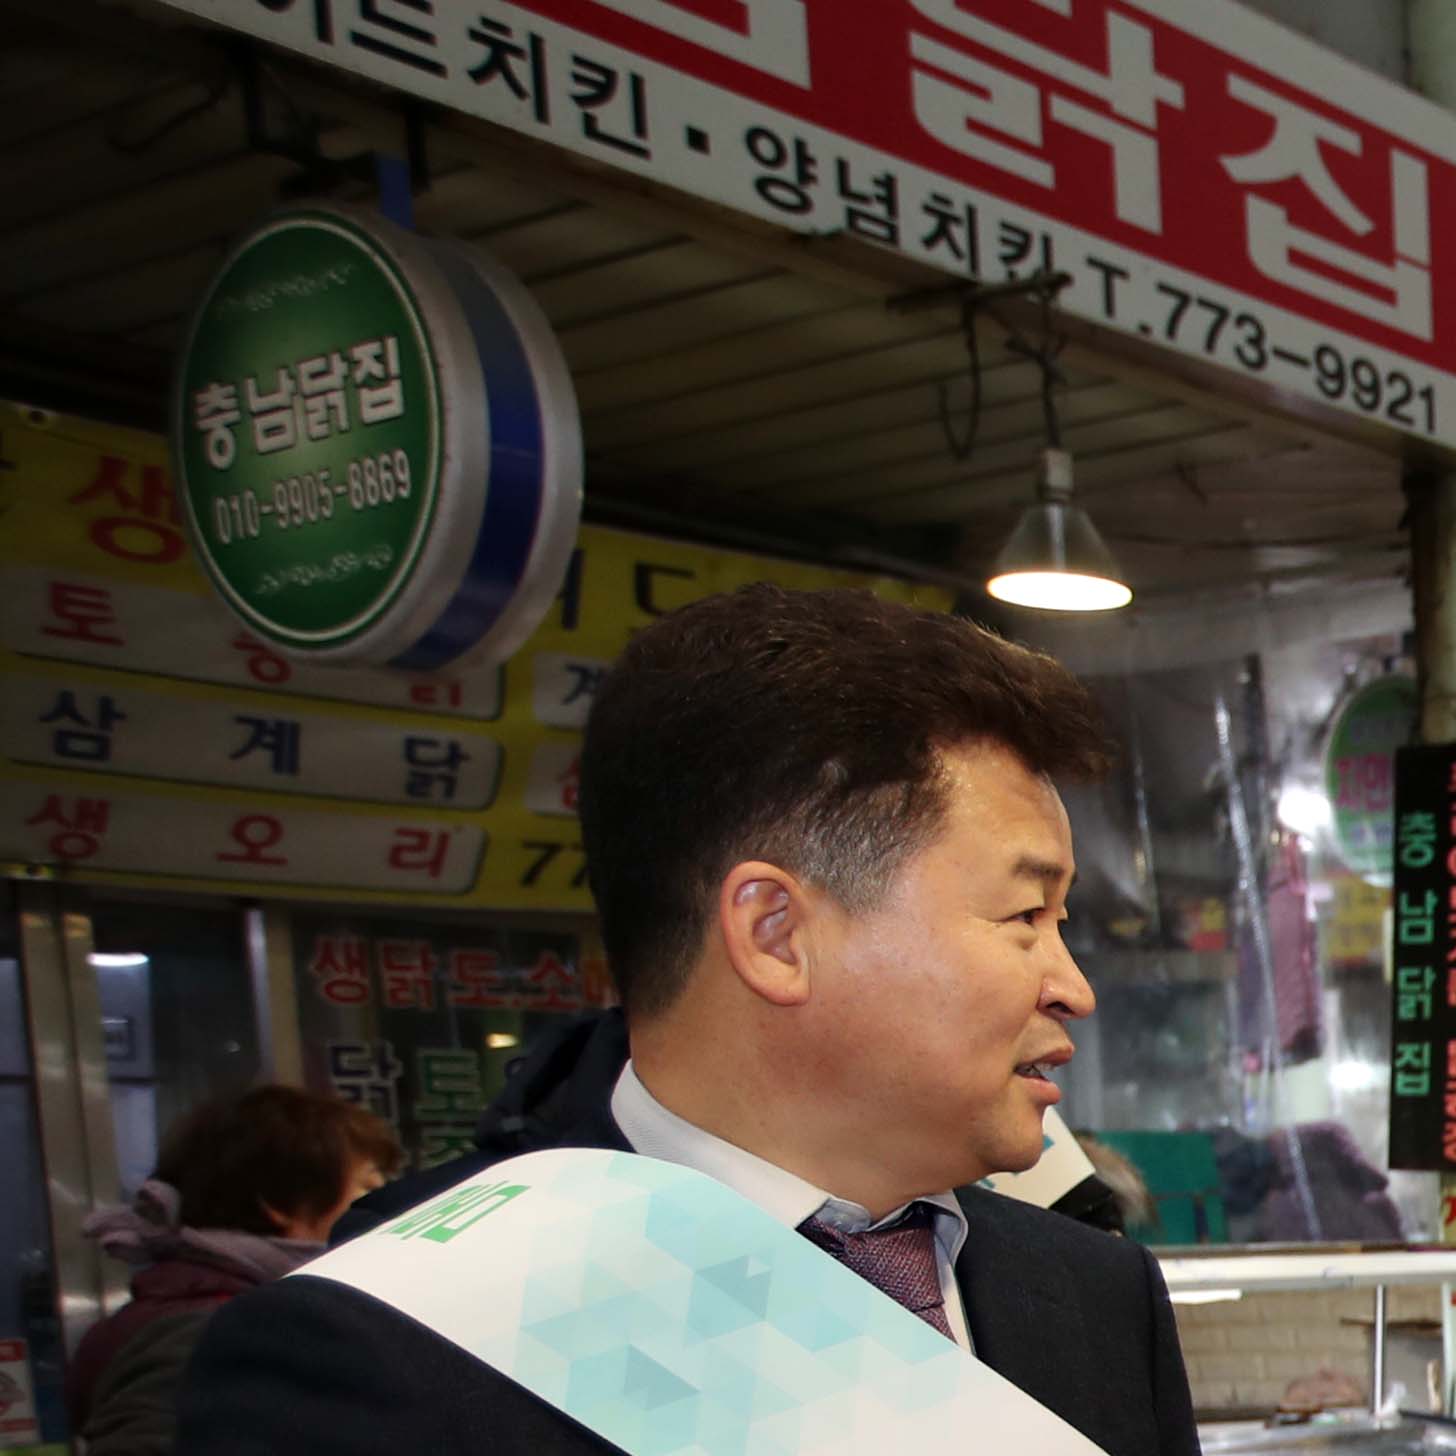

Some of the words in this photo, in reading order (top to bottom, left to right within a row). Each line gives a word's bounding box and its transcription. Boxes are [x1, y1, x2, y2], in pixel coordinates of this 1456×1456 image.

[584, 0, 1435, 343] 닭집
[194, 335, 406, 470] 충남닭집
[1086, 256, 1437, 433] T.773-9921
[212, 448, 412, 544] 010-9905-8869
